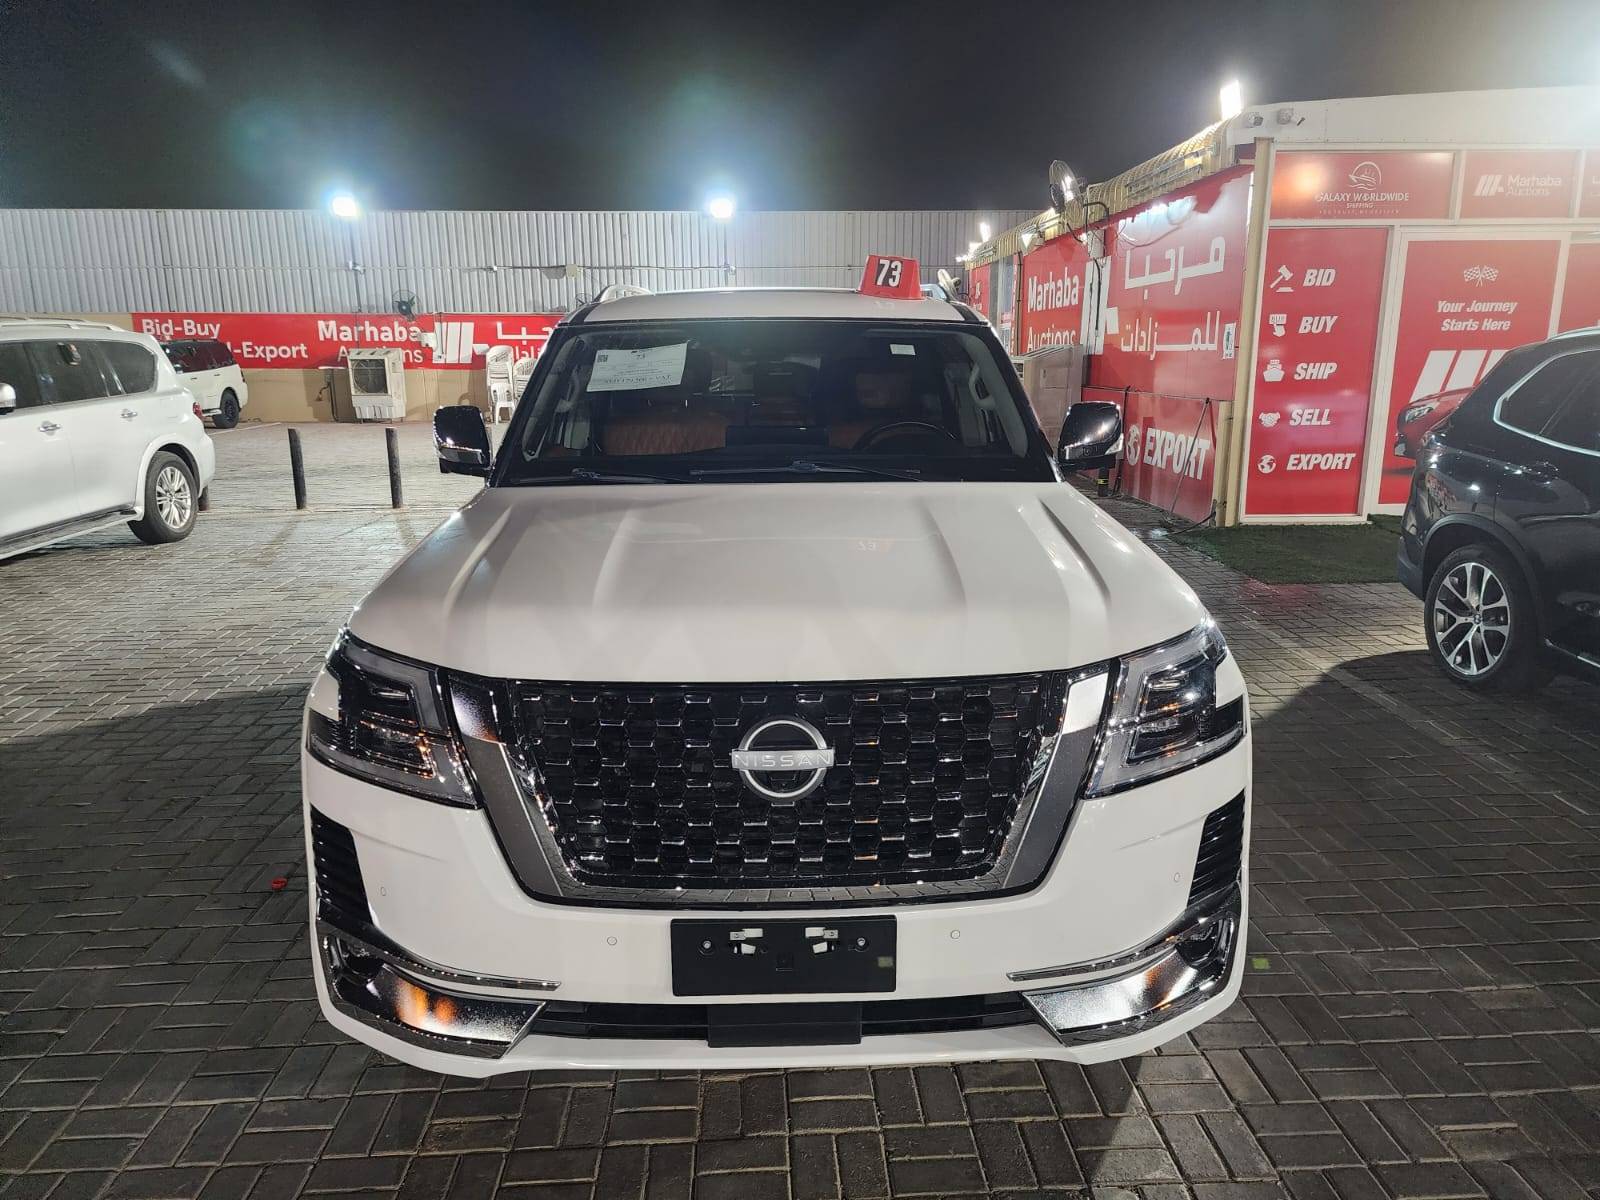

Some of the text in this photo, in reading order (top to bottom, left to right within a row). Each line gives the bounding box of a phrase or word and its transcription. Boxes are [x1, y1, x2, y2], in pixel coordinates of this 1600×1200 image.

[1353, 192, 1409, 201] WORLDWIDE
[876, 259, 902, 287] 73
[1124, 236, 1226, 300] مرحبا
[1303, 268, 1336, 287] BID
[1028, 266, 1080, 313] Marhaba
[1437, 300, 1517, 314] Your Journey
[142, 318, 220, 339] Bid-Buy
[1299, 316, 1338, 334] BUY
[1441, 319, 1511, 331] Starts Here
[1120, 310, 1221, 361] للمزادات
[1294, 362, 1337, 380] SHIP
[1289, 408, 1331, 426] SELL
[1143, 427, 1211, 480] EXPORT
[1286, 453, 1355, 470] EXPORT
[734, 751, 832, 767] NISSAN
